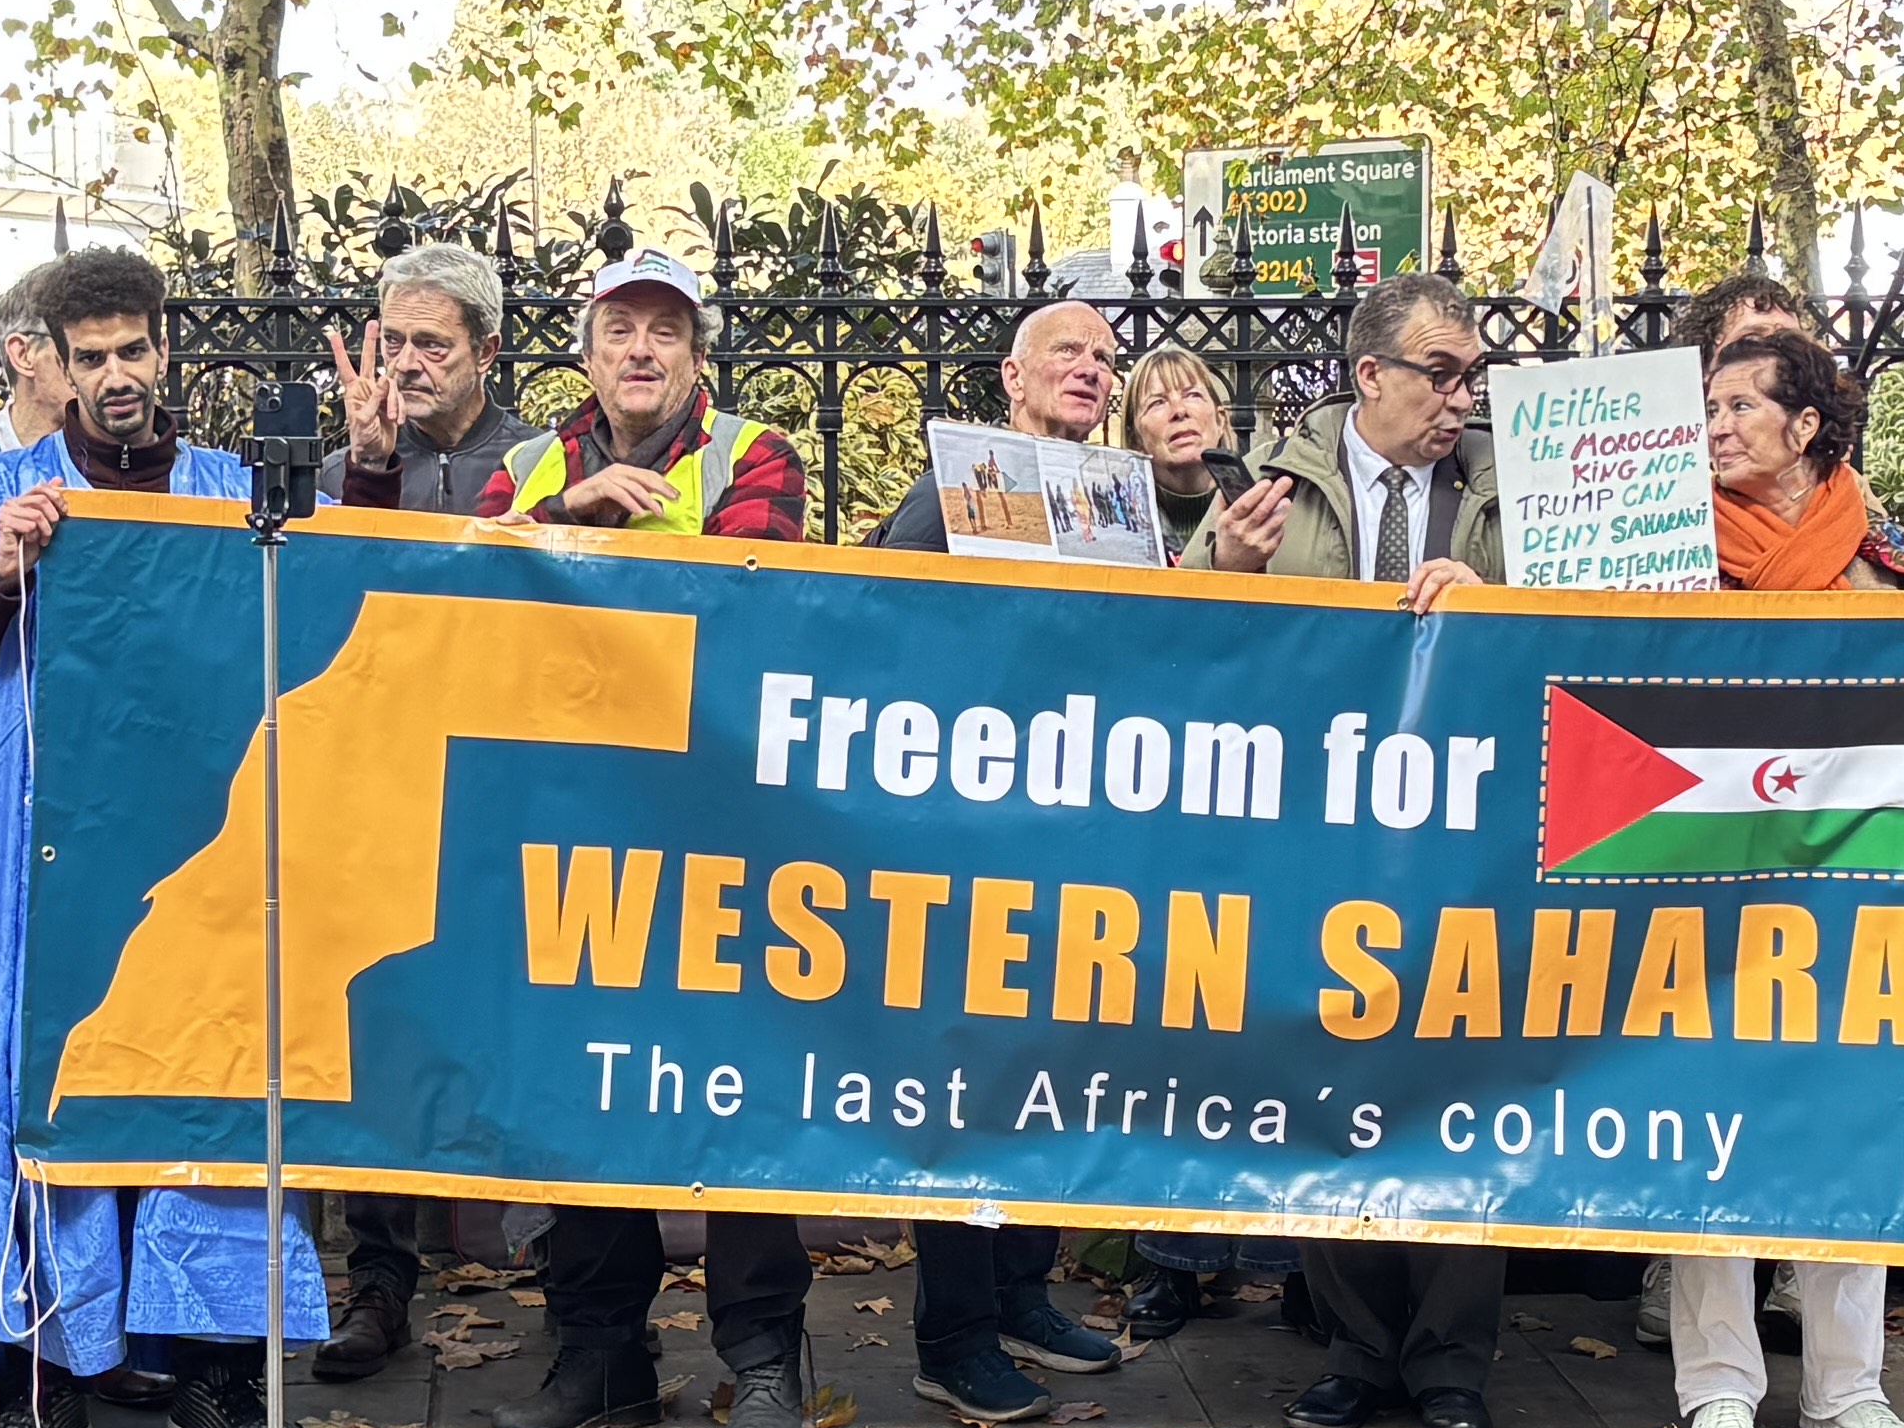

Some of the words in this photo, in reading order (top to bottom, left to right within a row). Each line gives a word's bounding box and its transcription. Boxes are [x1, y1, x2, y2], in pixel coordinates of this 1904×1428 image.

[1229, 161, 1336, 189] arliament
[1340, 158, 1415, 184] Square
[1227, 223, 1305, 246] ctoria
[1309, 220, 1382, 243] staon
[1570, 423, 1703, 460] MOROCCAN
[1642, 452, 1697, 477] NOR
[1516, 488, 1614, 521] TRUMP
[1621, 479, 1676, 508] CAN
[1523, 524, 1601, 554] DENY
[1522, 557, 1592, 587] SELF
[754, 670, 1285, 821] Freedom
[1323, 711, 1497, 832] for
[520, 842, 1252, 1033] WESTERN
[585, 1041, 746, 1118] The
[801, 1052, 967, 1131] last
[1439, 1088, 1745, 1182] colony
